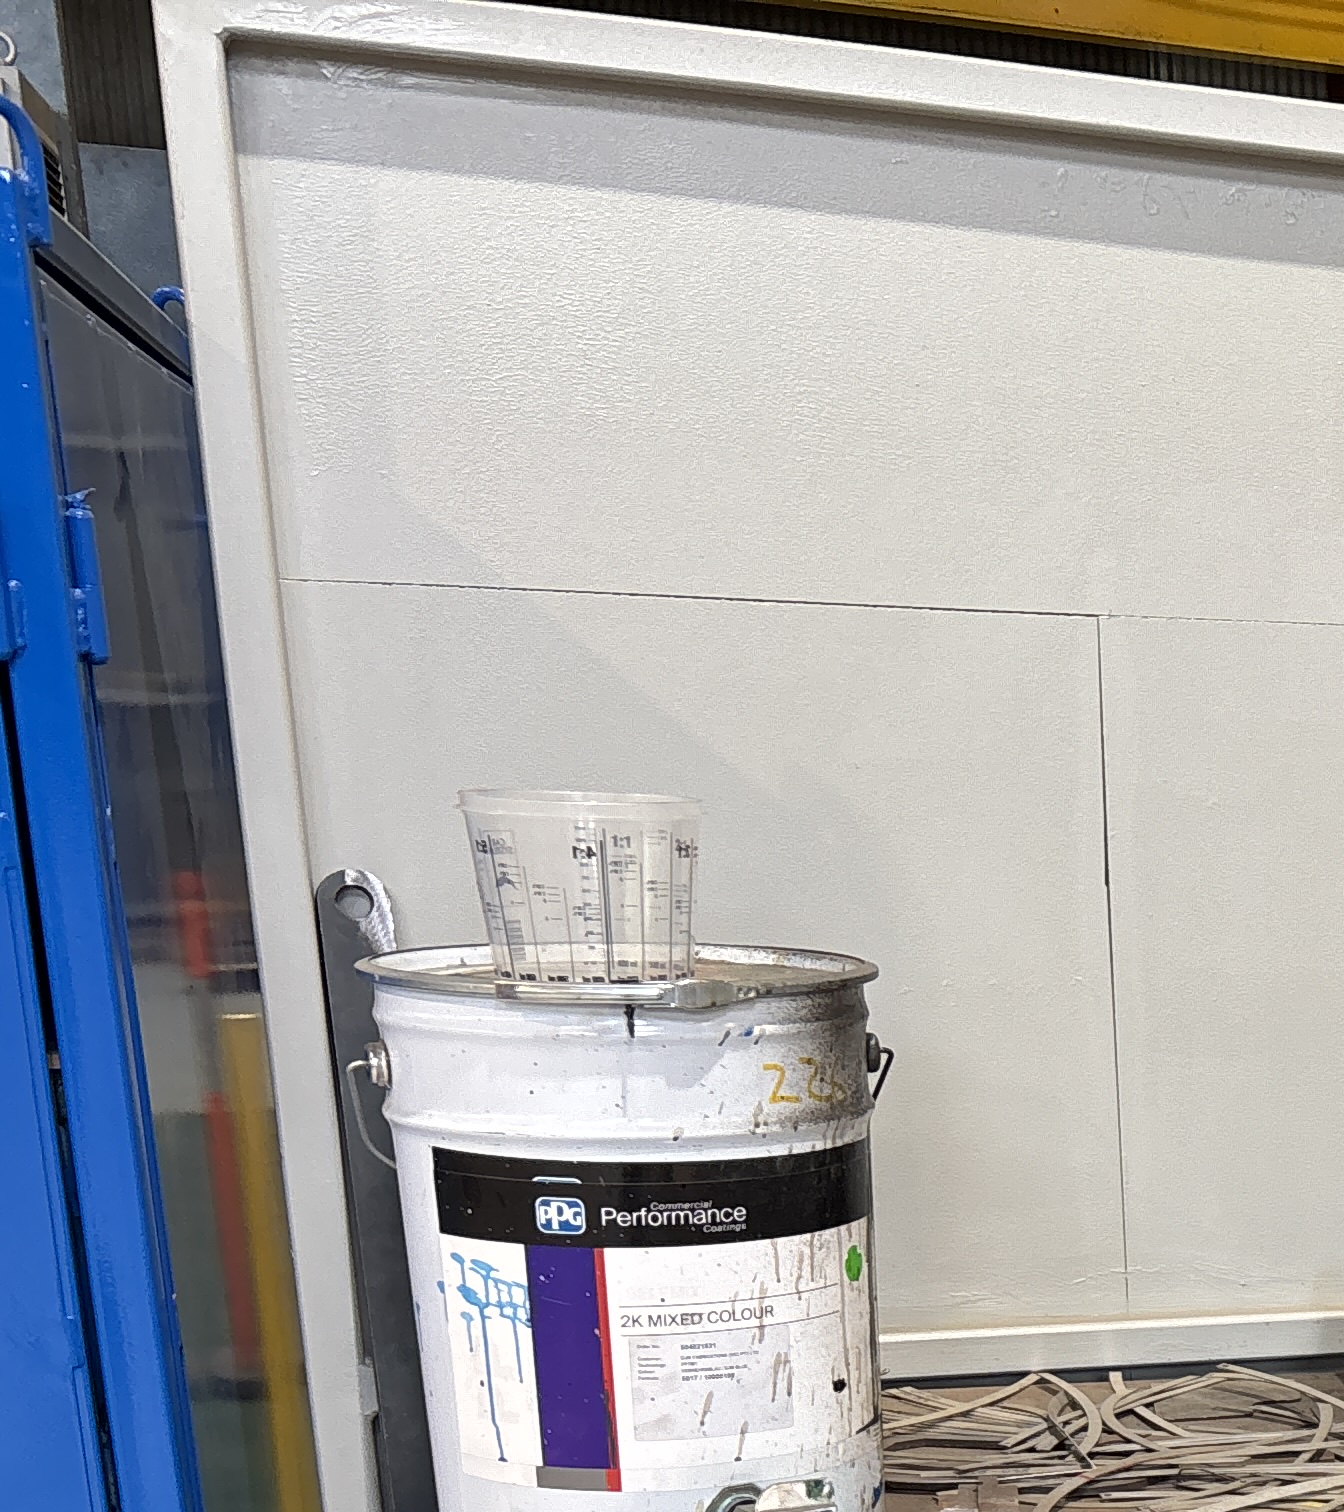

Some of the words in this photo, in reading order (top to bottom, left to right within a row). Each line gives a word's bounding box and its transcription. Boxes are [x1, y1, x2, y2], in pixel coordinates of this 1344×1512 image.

[539, 1201, 582, 1230] PPG
[650, 1200, 713, 1211] Commercial
[601, 1206, 747, 1226] Performance
[703, 1223, 747, 1234] Coatings
[620, 1314, 644, 1328] 2K
[648, 1312, 704, 1328] MIXED
[707, 1305, 775, 1324] COLOUR
